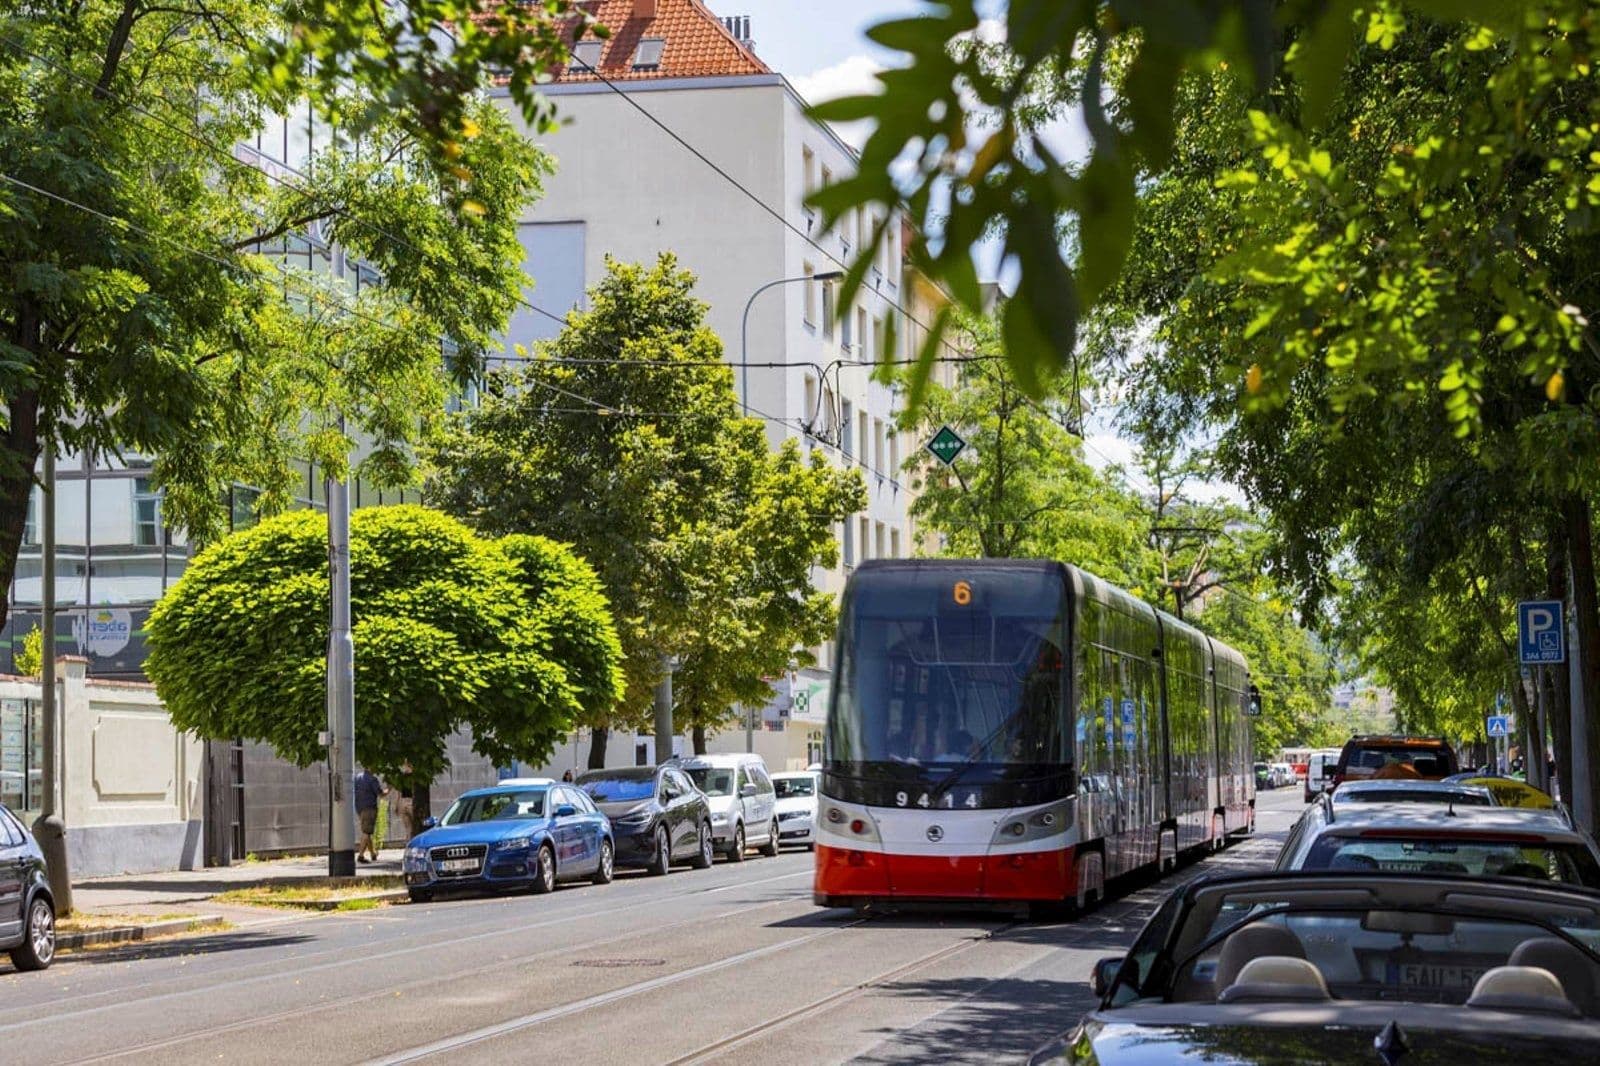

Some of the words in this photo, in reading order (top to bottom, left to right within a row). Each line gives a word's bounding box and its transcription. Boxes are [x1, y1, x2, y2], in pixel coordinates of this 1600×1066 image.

[954, 581, 971, 605] 6
[1528, 609, 1553, 644] P
[896, 791, 977, 808] 9414
